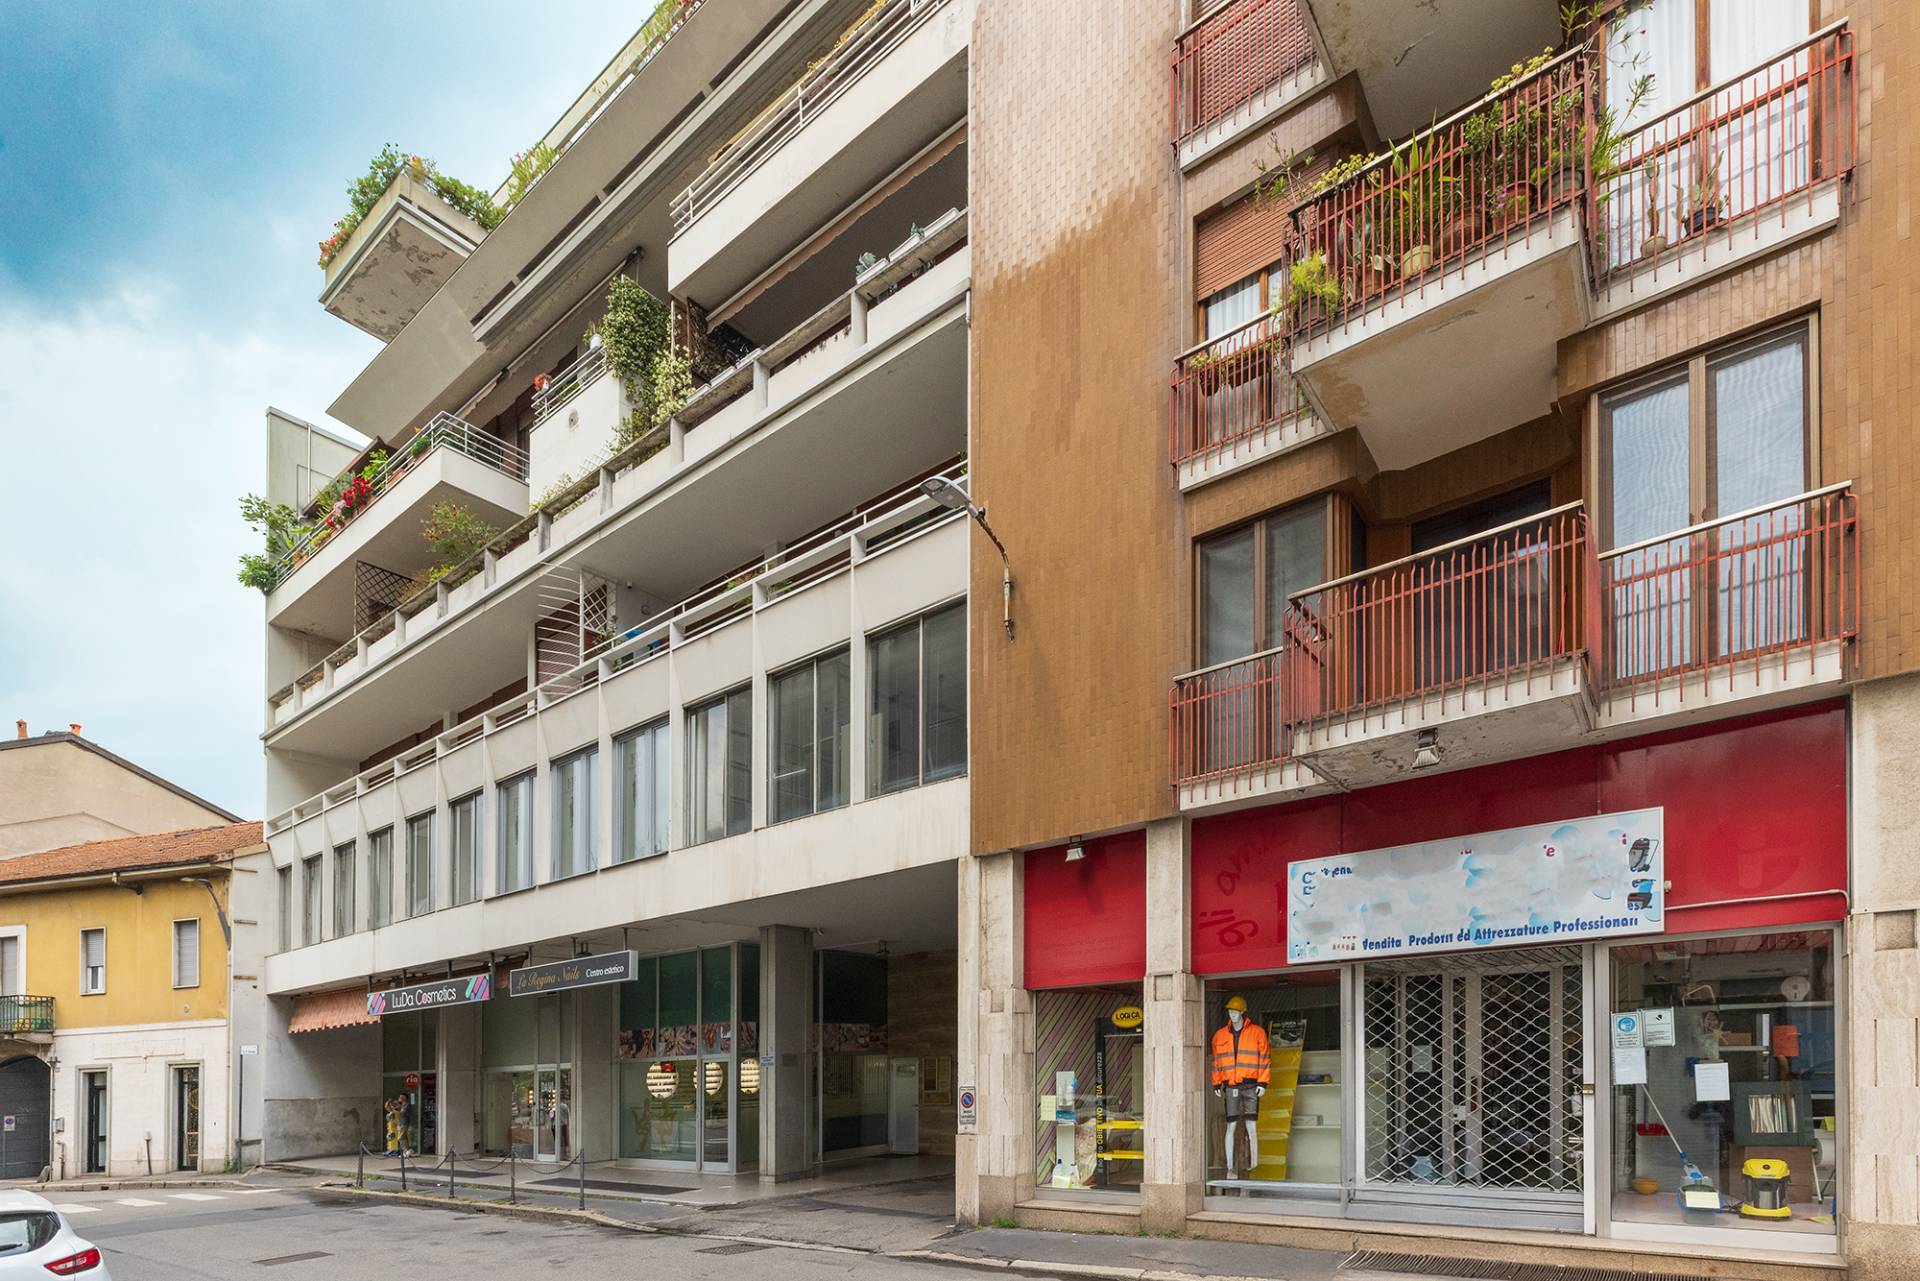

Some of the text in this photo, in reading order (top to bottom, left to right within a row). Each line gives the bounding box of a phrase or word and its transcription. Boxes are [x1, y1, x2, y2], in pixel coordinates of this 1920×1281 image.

[1362, 938, 1402, 951] Vendita
[1474, 924, 1549, 941] Attrezzature
[585, 963, 625, 979] Centro estetico
[392, 985, 457, 1009] LuDa Cosmetics
